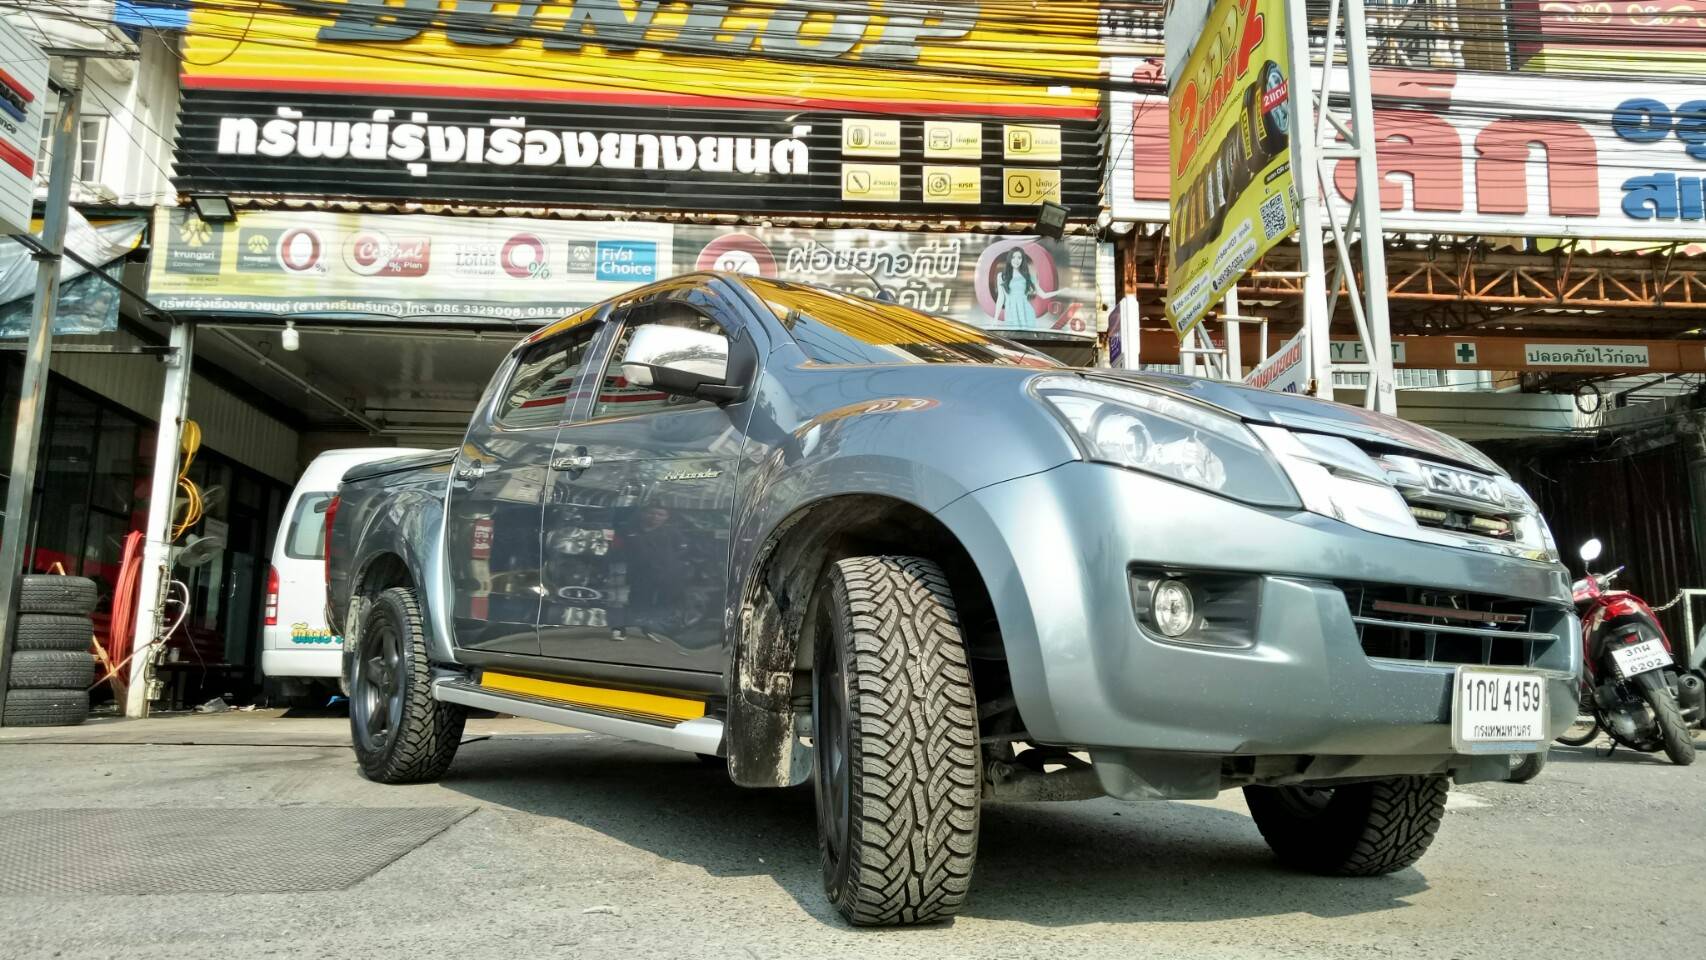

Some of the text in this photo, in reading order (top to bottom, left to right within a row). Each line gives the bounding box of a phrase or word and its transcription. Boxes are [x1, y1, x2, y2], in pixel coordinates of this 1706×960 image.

[216, 106, 812, 177] ทรัพย์รุ่งเรืองยางยนต์
[600, 260, 653, 276] Choice
[433, 304, 460, 314] 086
[527, 306, 553, 317] 089
[1527, 346, 1648, 364] ปลอดภัยไว้ก่อน
[1629, 658, 1664, 673] 6202
[1503, 680, 1540, 712] 4159
